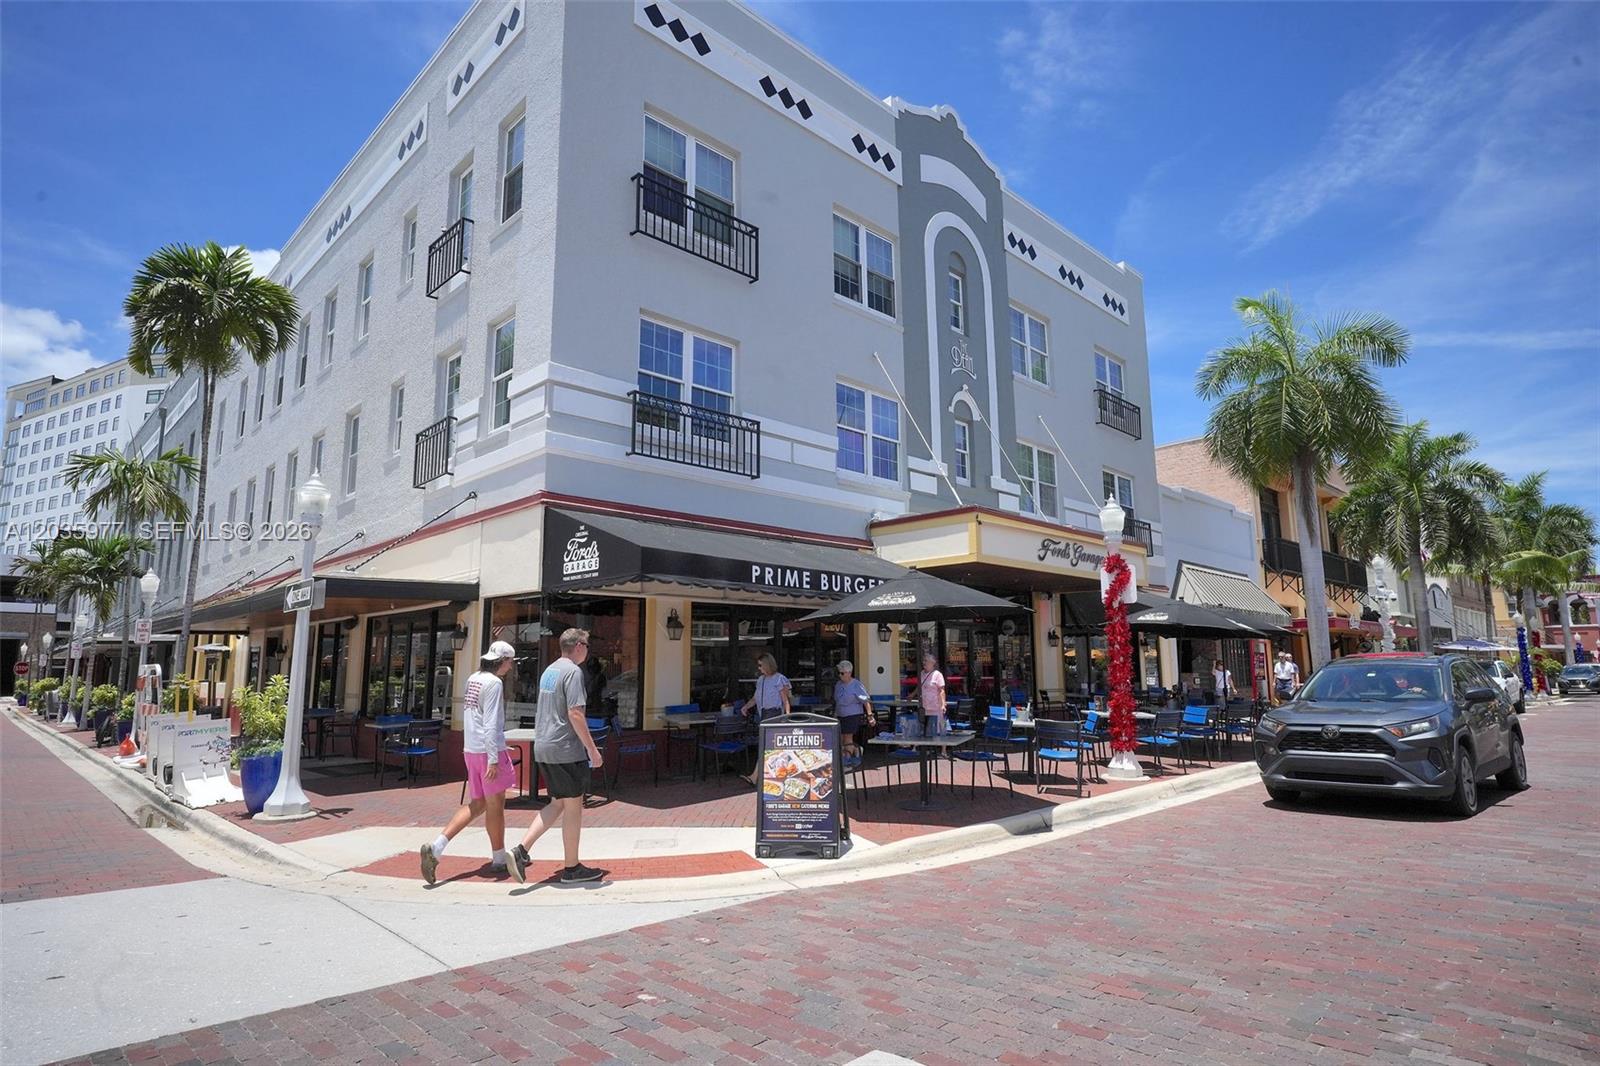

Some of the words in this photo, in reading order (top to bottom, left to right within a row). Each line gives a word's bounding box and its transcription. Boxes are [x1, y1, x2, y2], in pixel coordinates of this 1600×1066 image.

[564, 558, 600, 574] GARAGE
[751, 564, 811, 589] PRIME
[292, 590, 300, 602] ONE
[776, 735, 820, 747] CATERING
